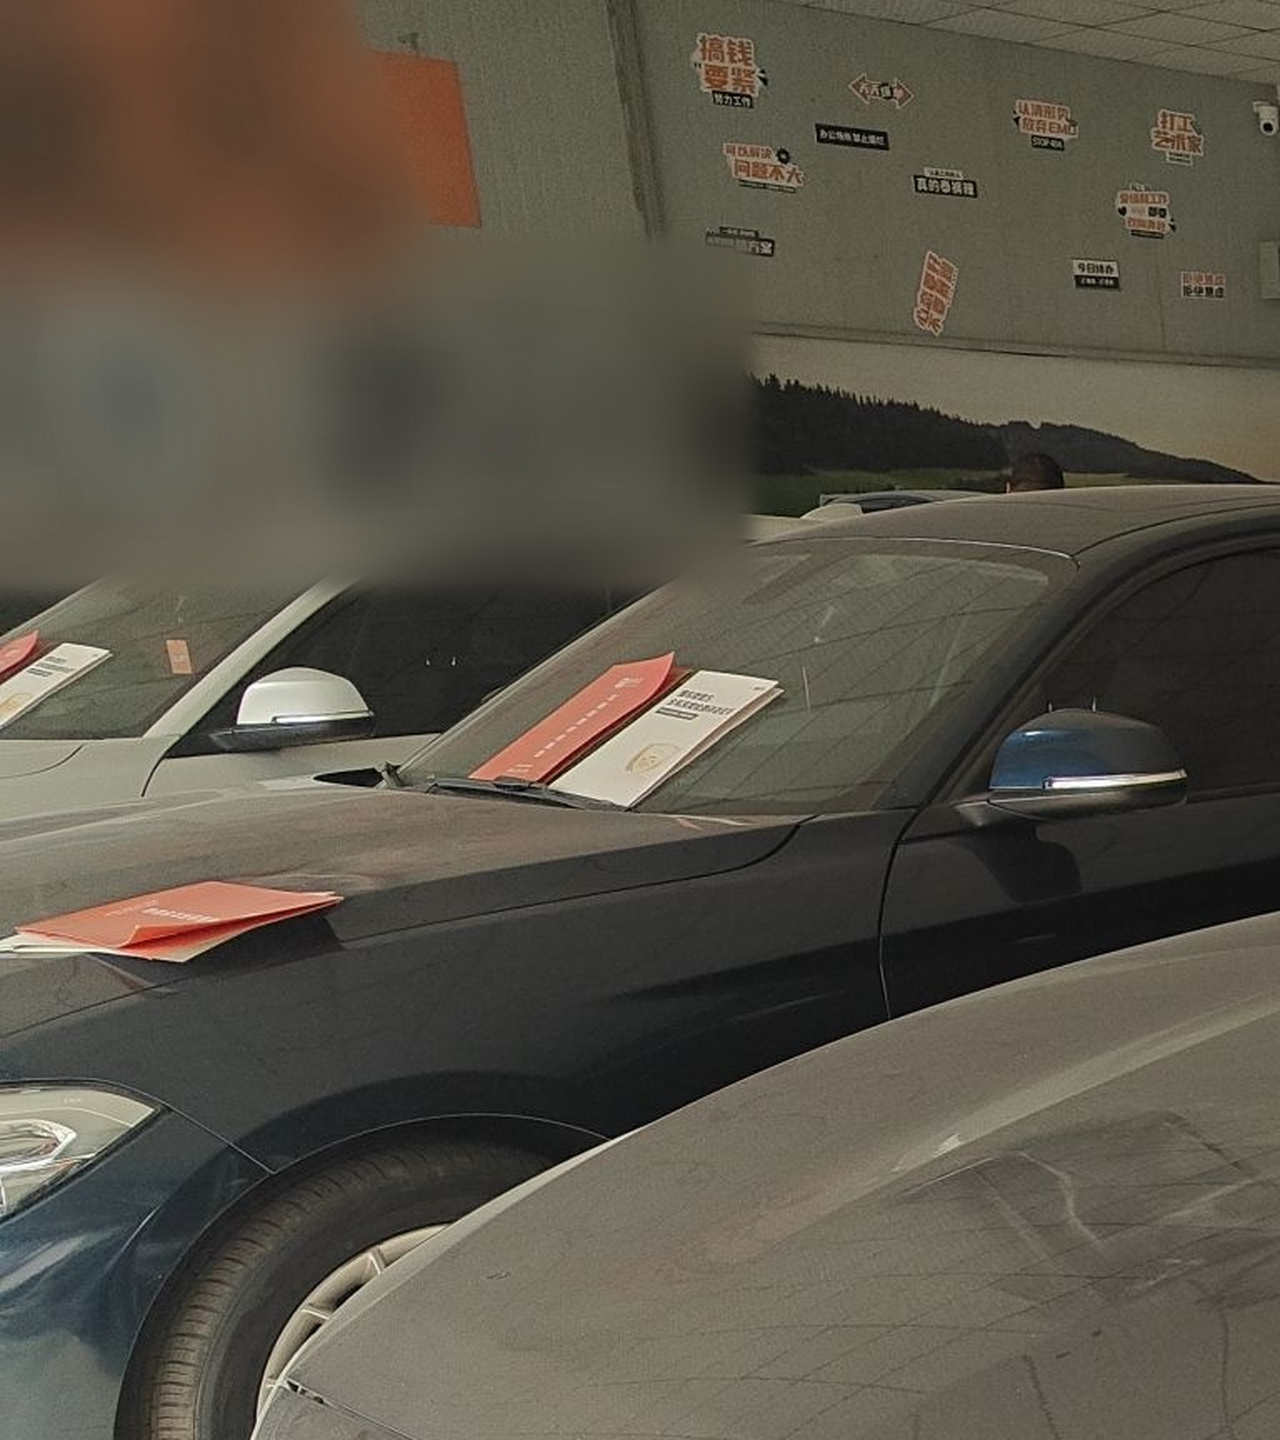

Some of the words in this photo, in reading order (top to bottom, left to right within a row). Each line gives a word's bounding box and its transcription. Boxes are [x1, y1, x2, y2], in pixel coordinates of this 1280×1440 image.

[700, 36, 753, 66] 搞钱
[1160, 112, 1193, 133] 打工
[1152, 130, 1202, 152] 艺术家
[734, 159, 804, 184] 问题不大
